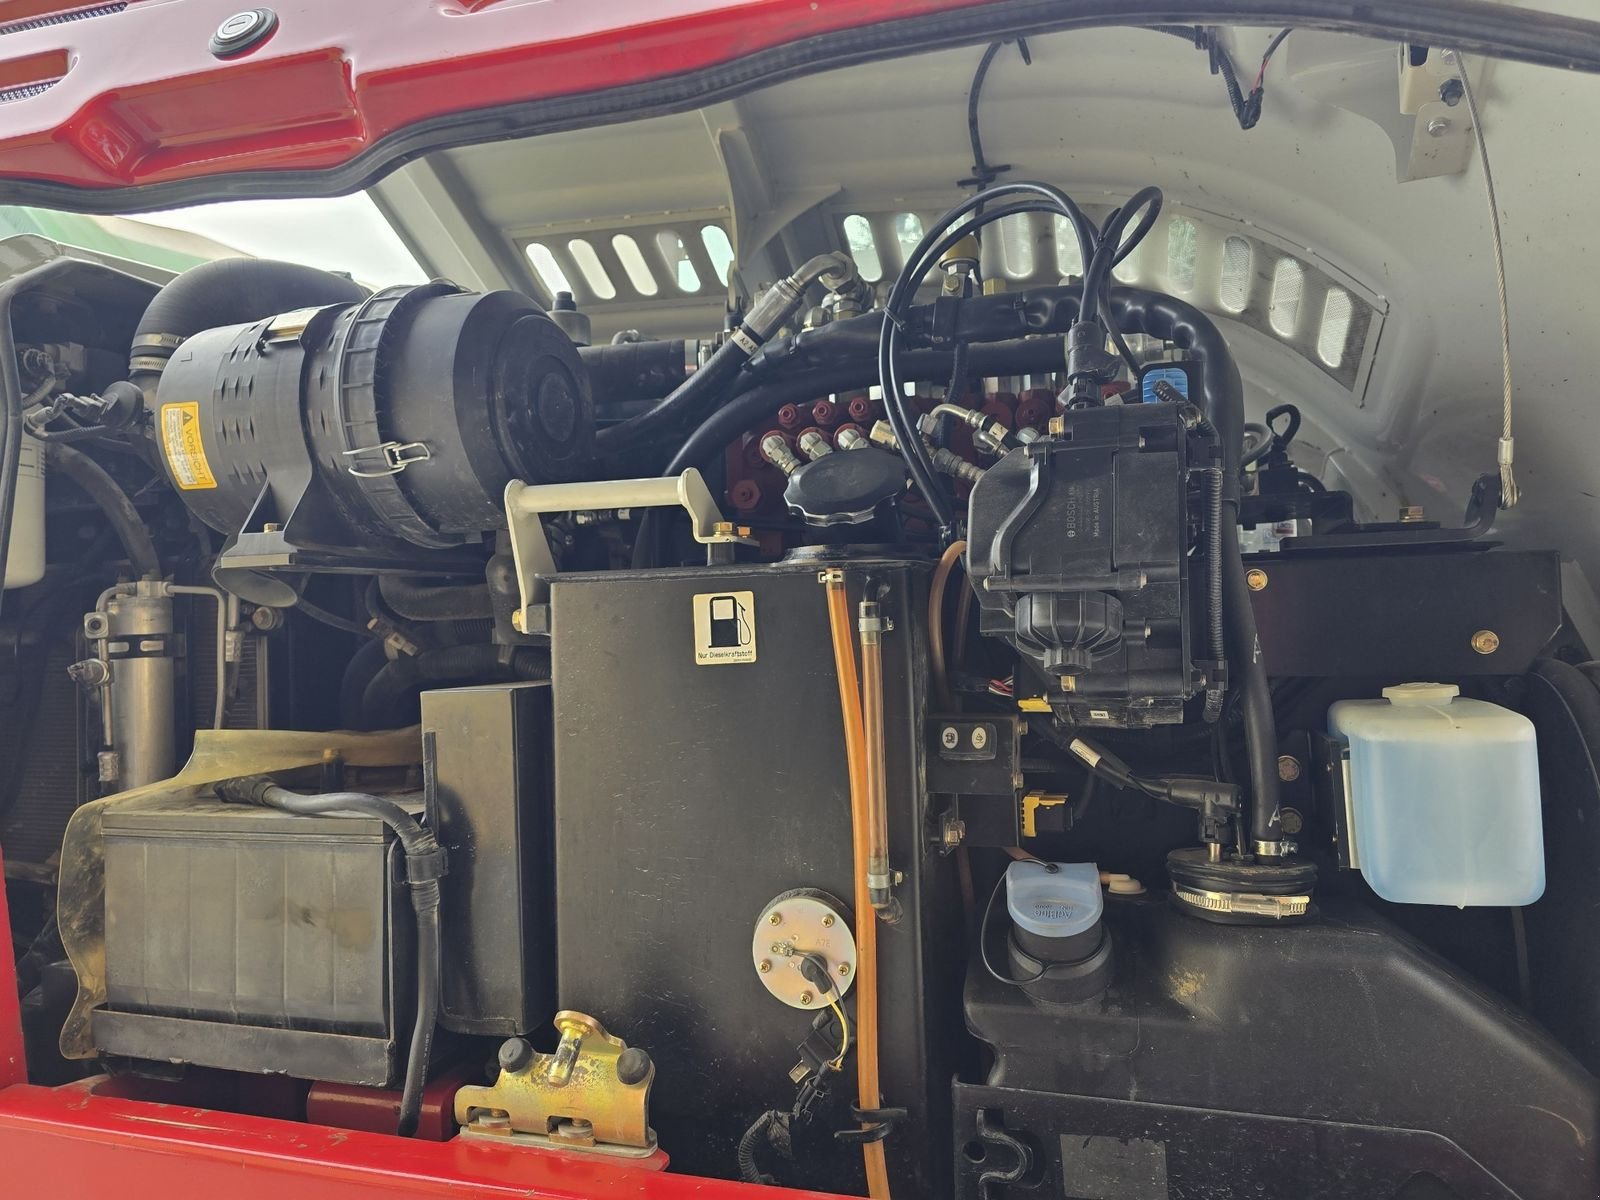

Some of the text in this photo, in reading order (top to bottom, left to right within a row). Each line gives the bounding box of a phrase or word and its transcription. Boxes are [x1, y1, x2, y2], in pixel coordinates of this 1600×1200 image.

[186, 430, 207, 480] VORSICHT
[1066, 497, 1076, 529] BOSCH
[710, 650, 753, 658] Dieselkraftstoff
